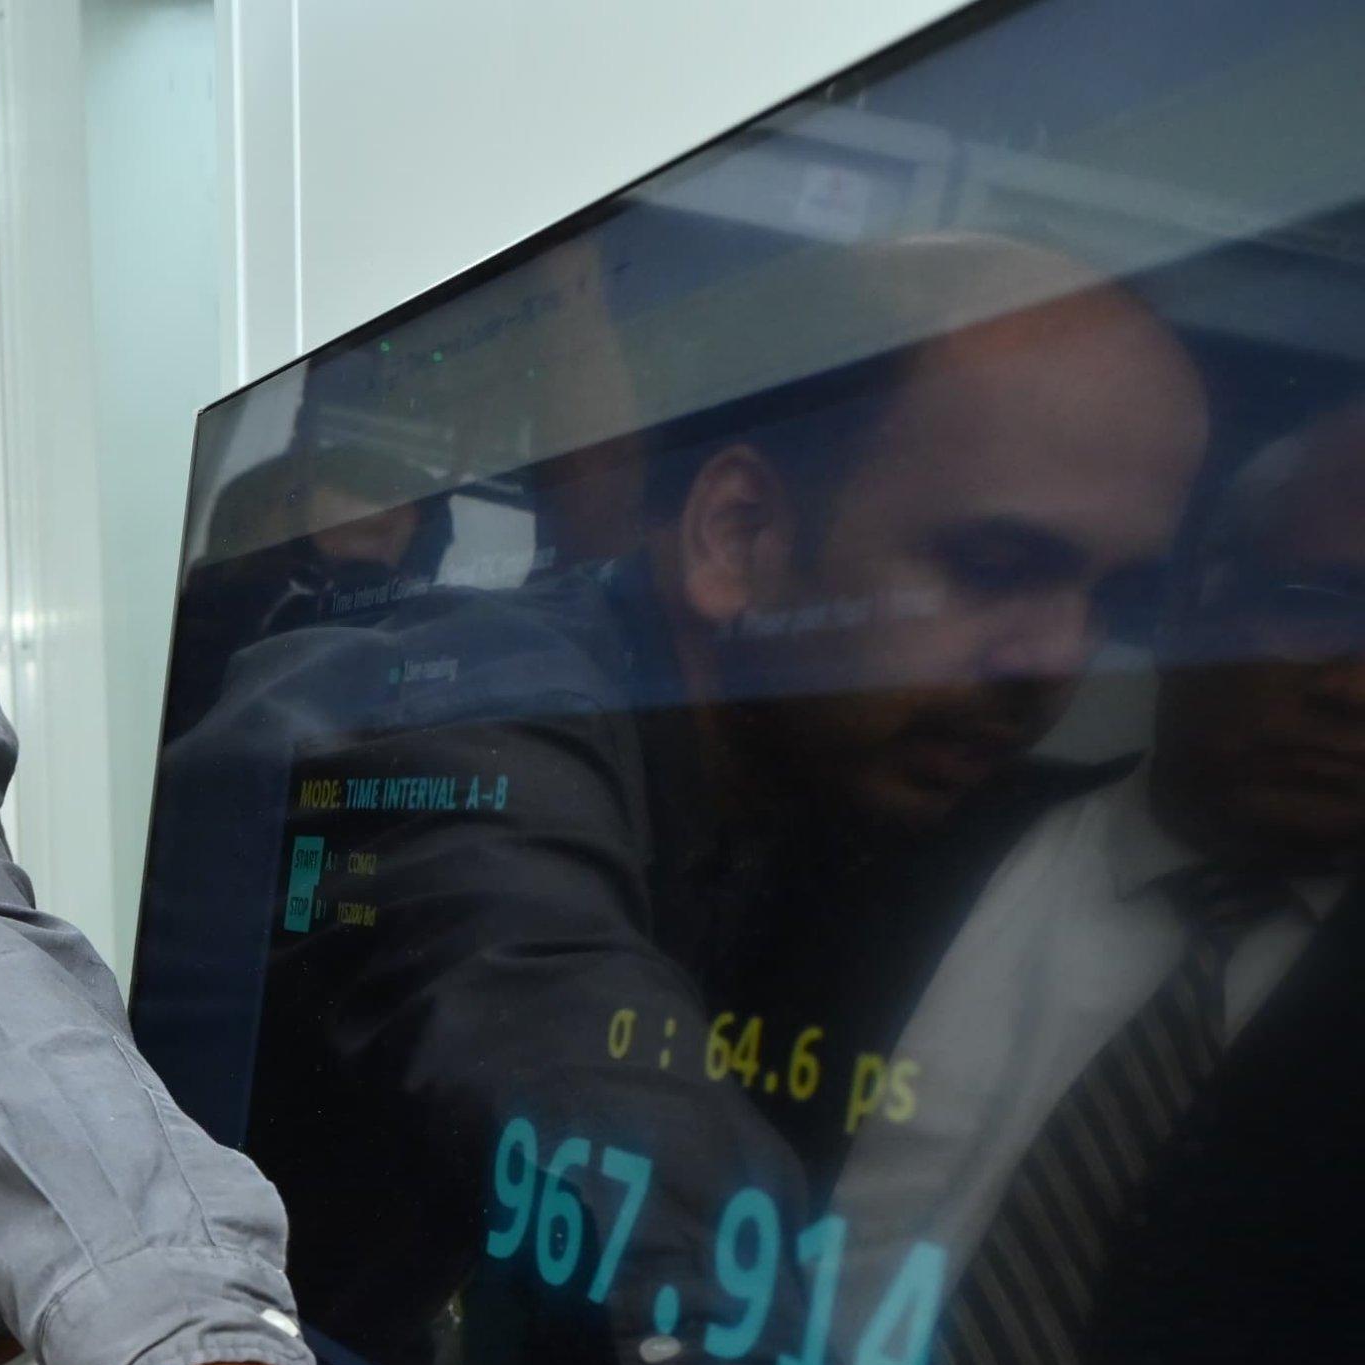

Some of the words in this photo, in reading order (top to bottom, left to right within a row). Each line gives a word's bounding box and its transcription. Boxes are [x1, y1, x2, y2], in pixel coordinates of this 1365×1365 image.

[299, 779, 342, 809] MODE:
[345, 776, 379, 810] TIME
[382, 775, 458, 811] INTERVAL
[705, 1011, 825, 1099] 64.6
[846, 1053, 922, 1133] ps
